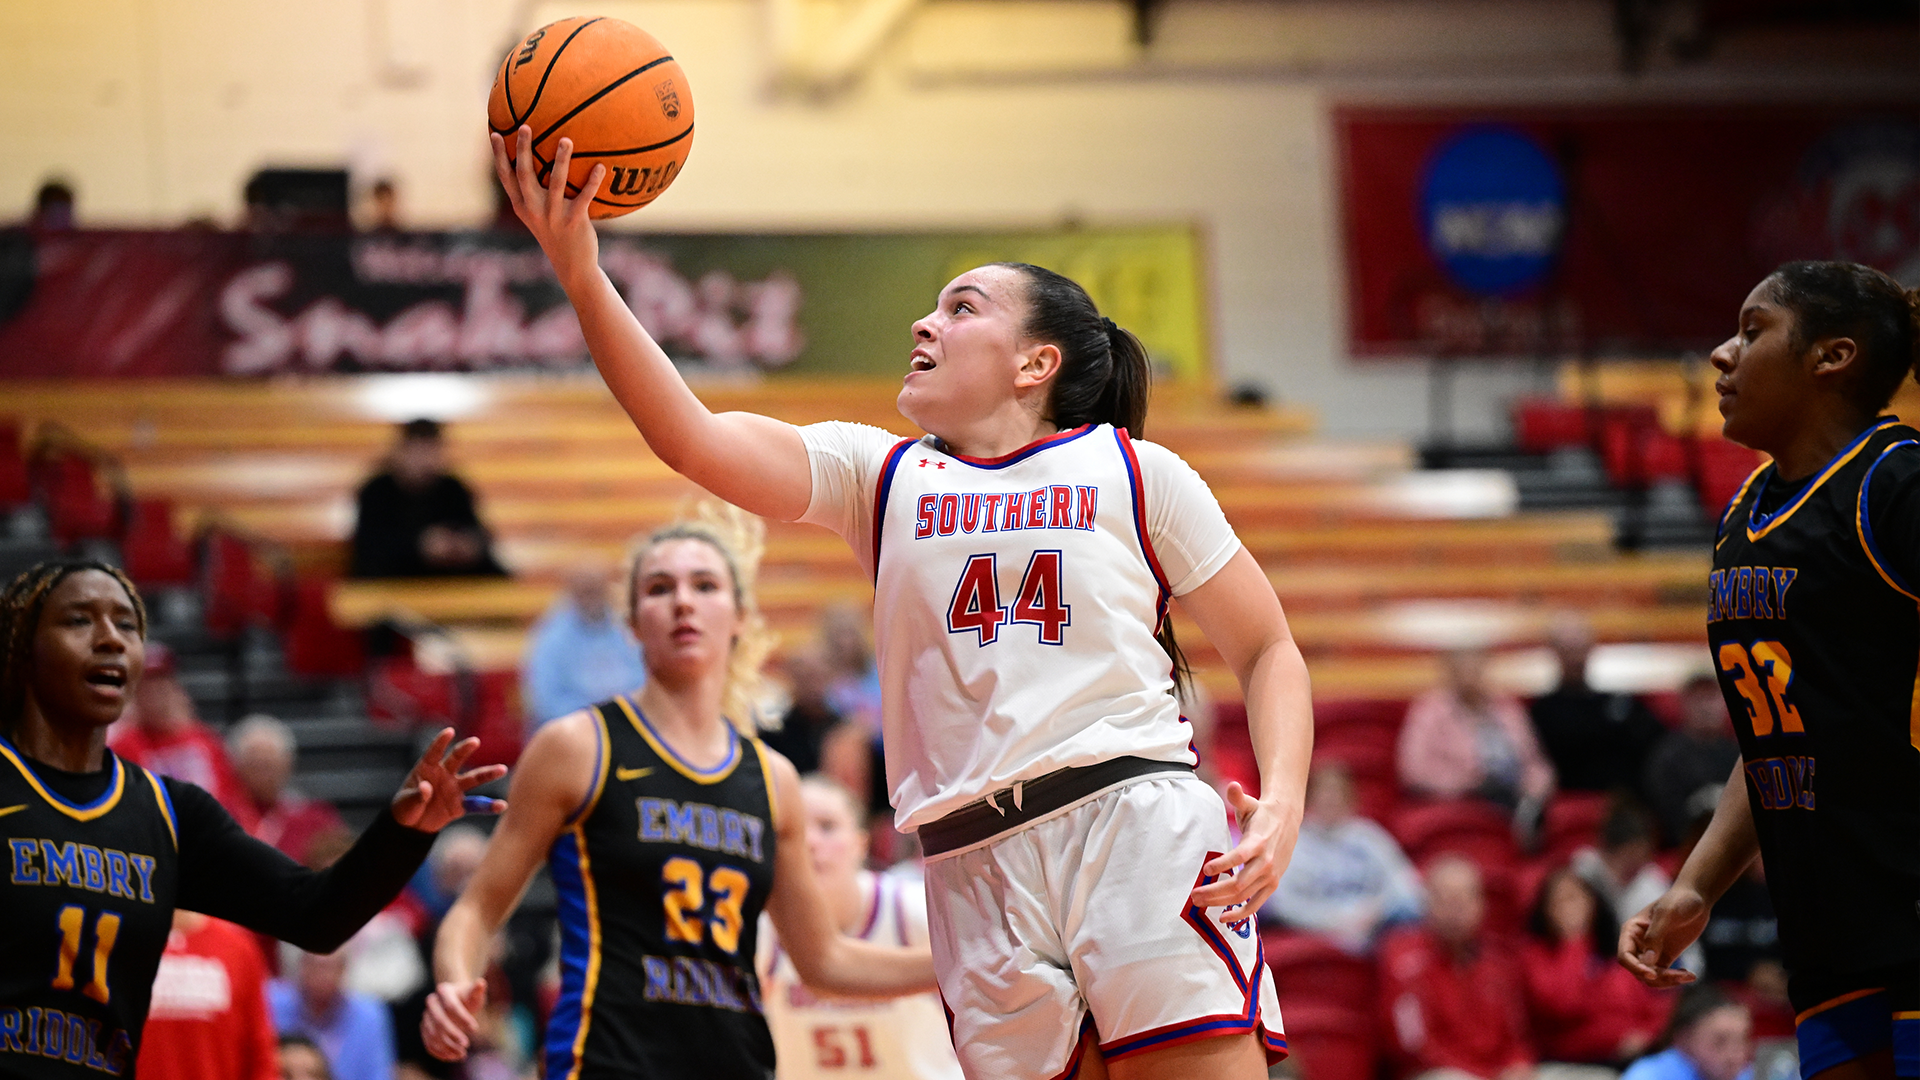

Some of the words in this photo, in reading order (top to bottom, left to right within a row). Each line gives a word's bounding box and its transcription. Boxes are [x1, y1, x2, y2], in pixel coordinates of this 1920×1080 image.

[915, 485, 1098, 540] SOUTHERN
[946, 549, 1071, 648] 44
[1718, 638, 1806, 740] 32
[8, 838, 156, 904] EMBRY
[636, 796, 764, 863] EMBRY
[661, 855, 752, 955] 23
[52, 903, 123, 1005] 11
[811, 1025, 877, 1070] 51
